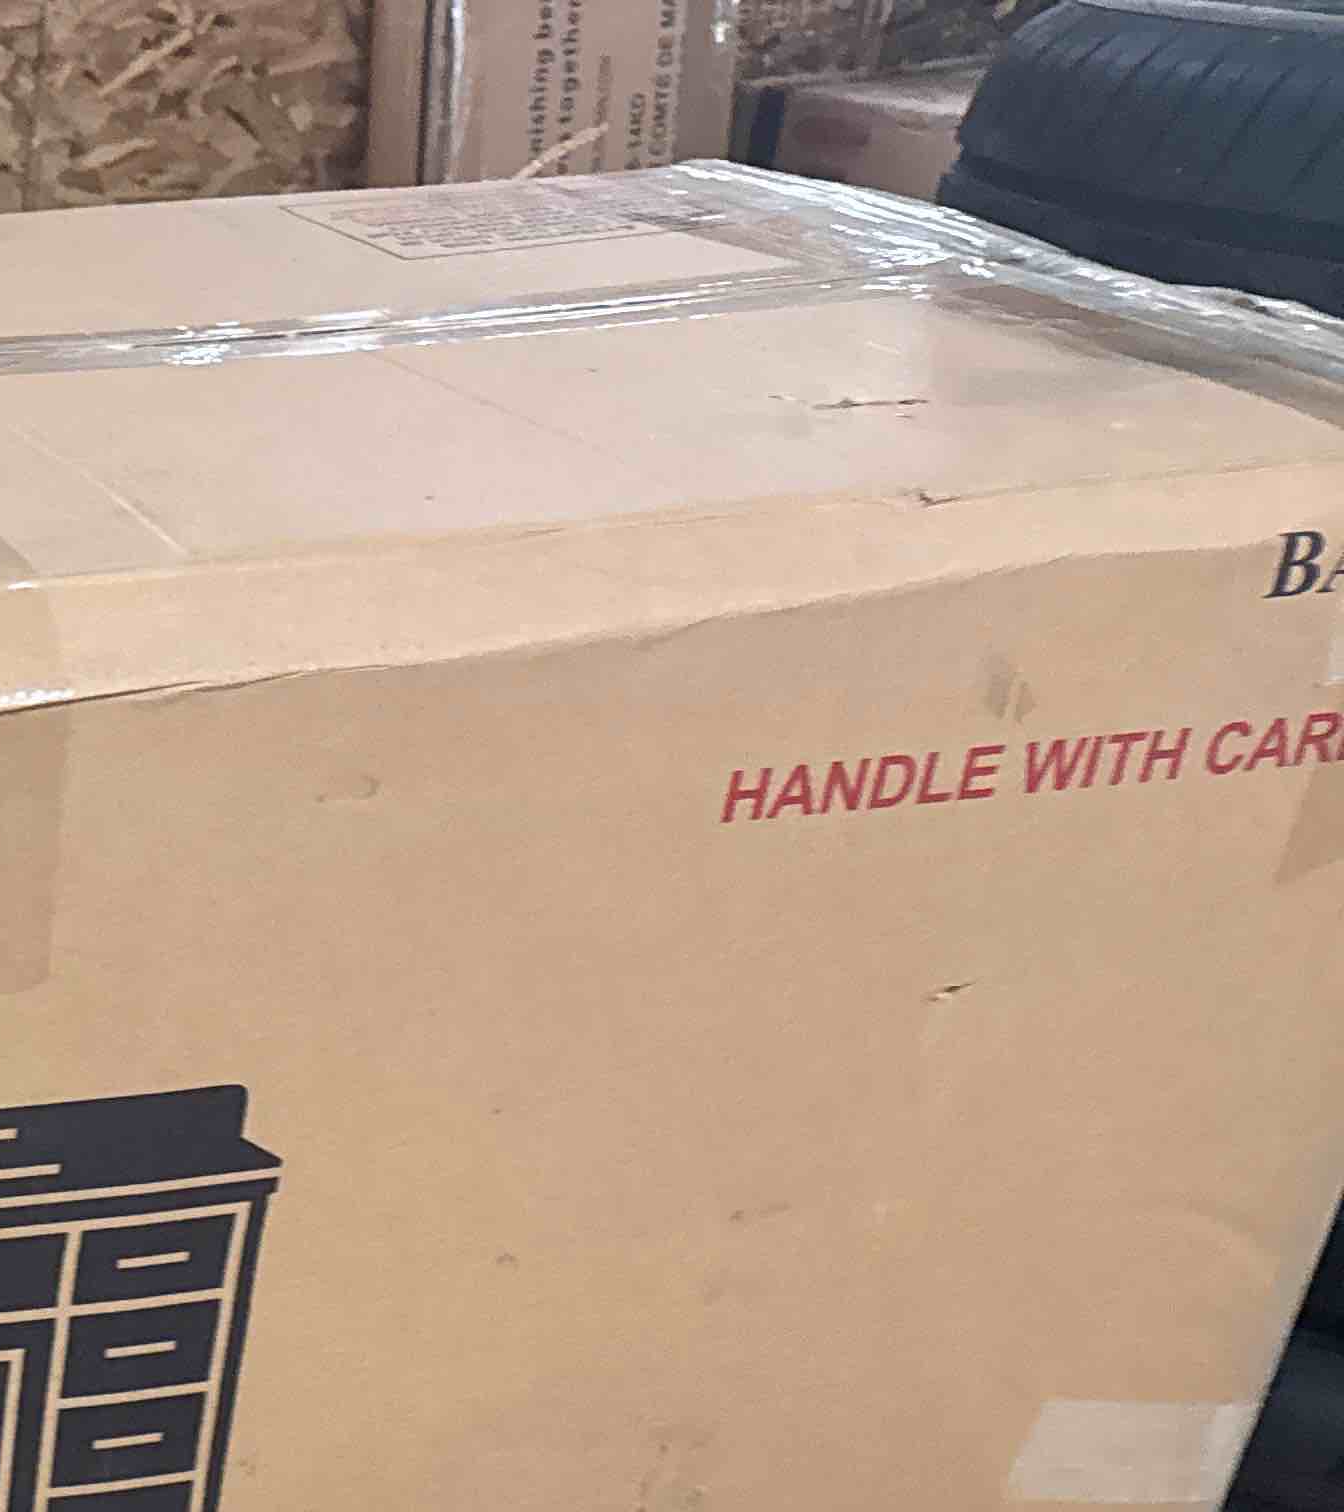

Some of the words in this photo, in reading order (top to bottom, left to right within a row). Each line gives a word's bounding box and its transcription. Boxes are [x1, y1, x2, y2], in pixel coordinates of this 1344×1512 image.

[720, 743, 1007, 824] HANDLE
[1023, 726, 1192, 795] WITH
[1205, 710, 1344, 776] CAR
